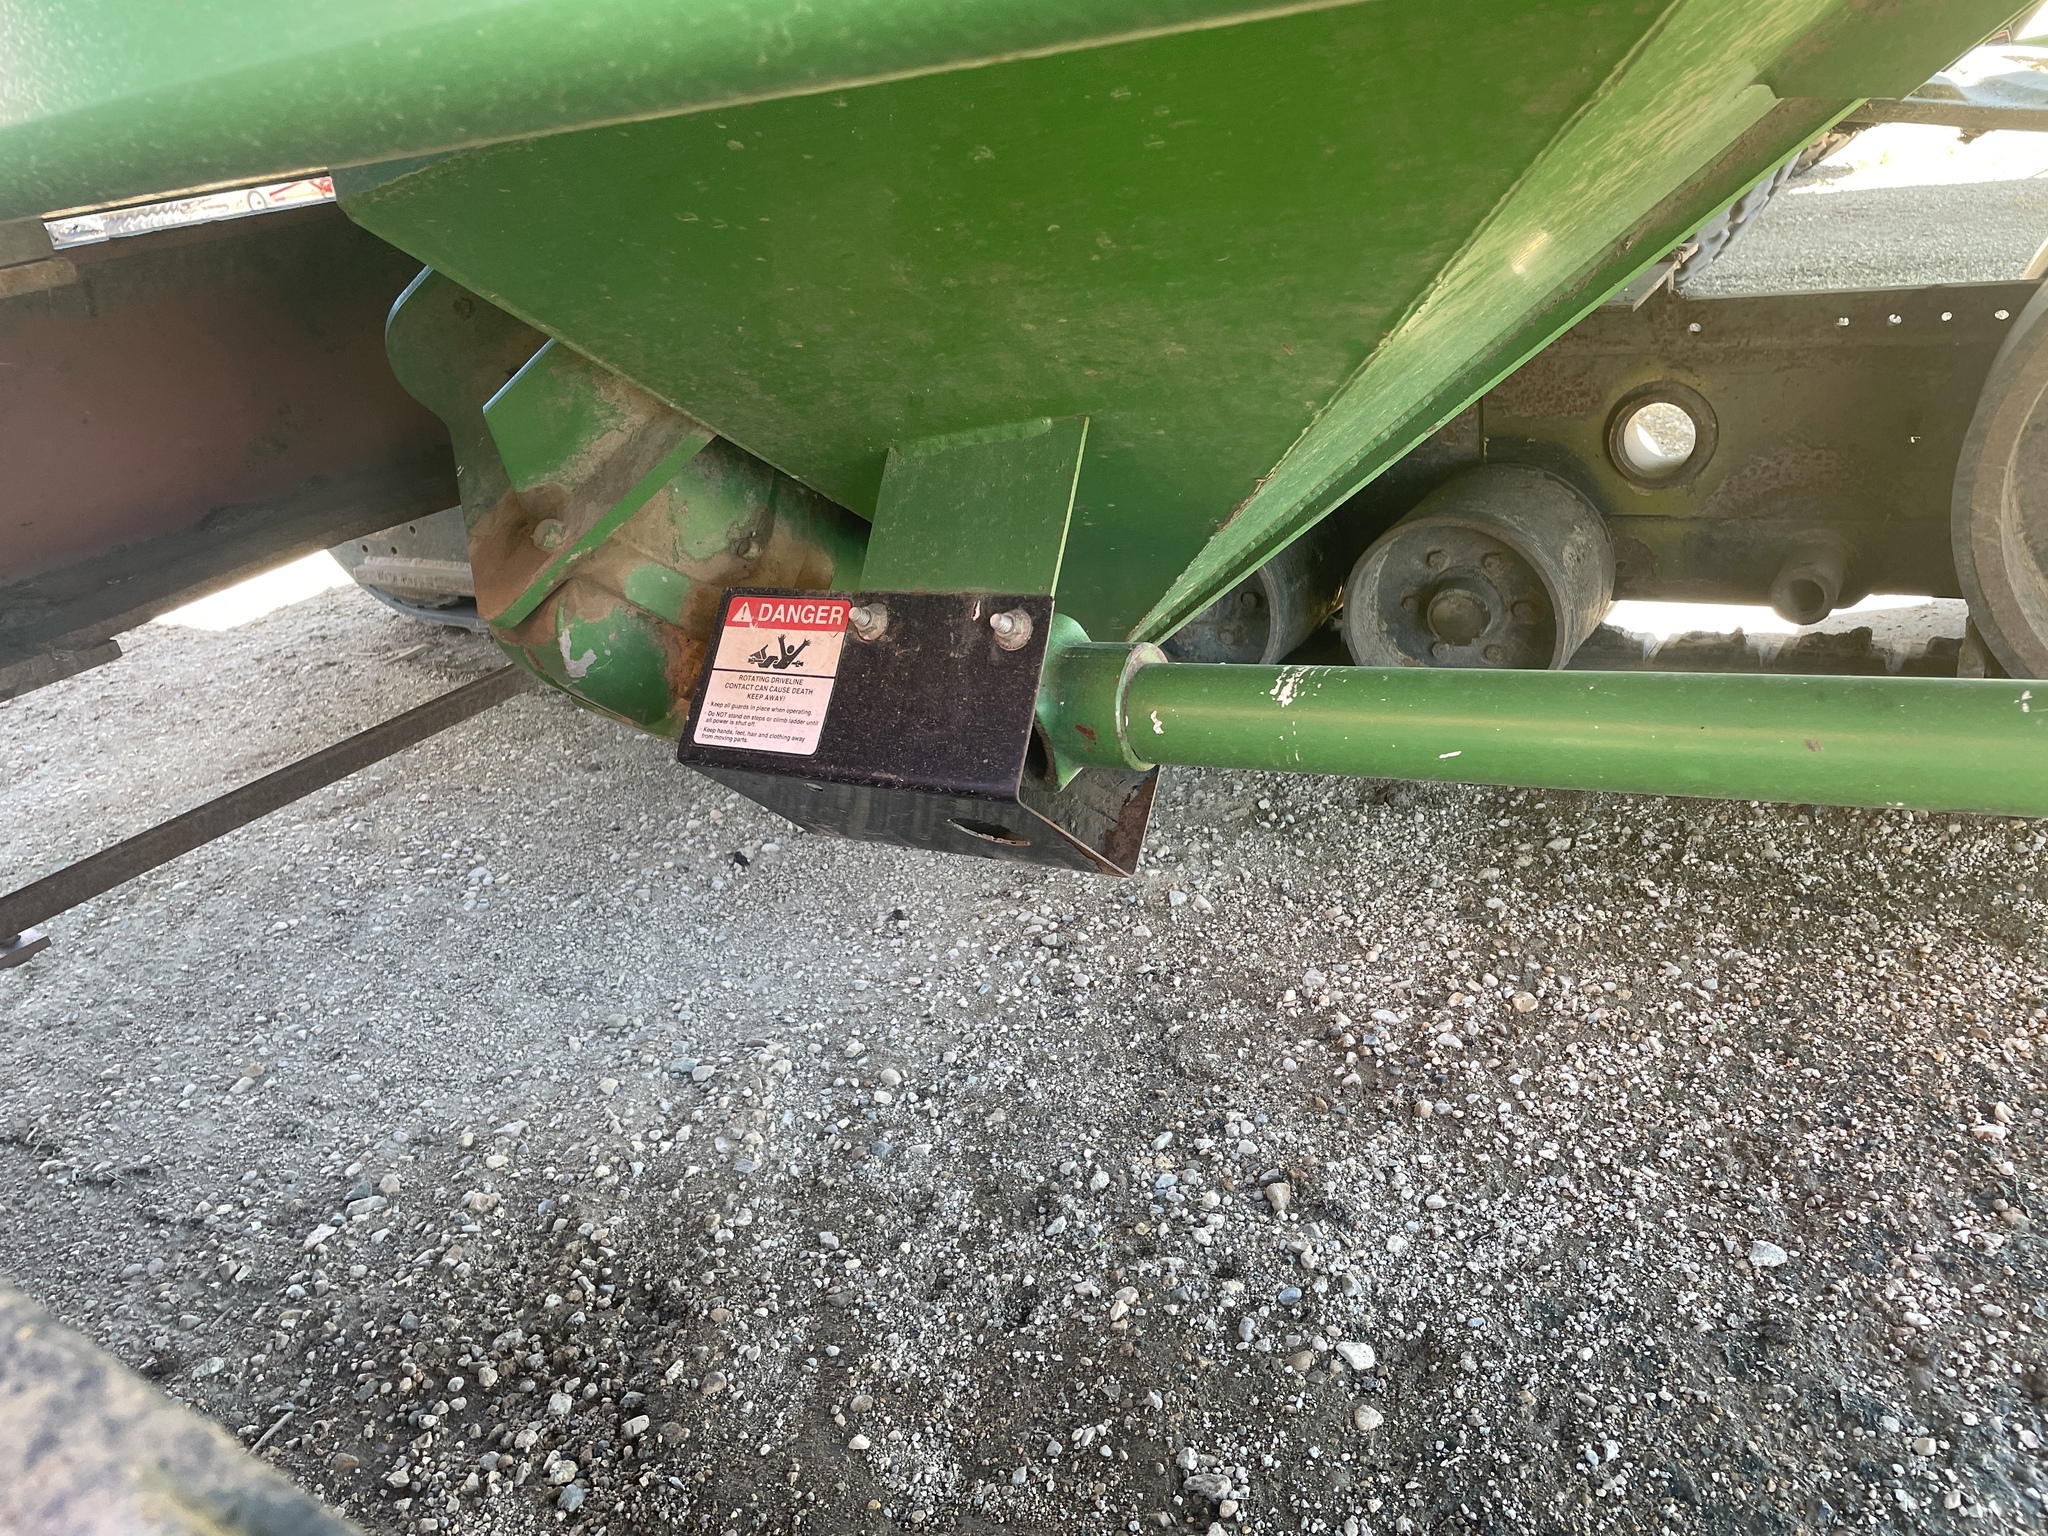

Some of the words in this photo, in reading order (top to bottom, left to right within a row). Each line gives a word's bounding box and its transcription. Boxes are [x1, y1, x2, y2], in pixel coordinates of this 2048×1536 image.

[758, 603, 844, 625] DANGER
[739, 675, 770, 683] ROTATING
[769, 733, 790, 741] clothing
